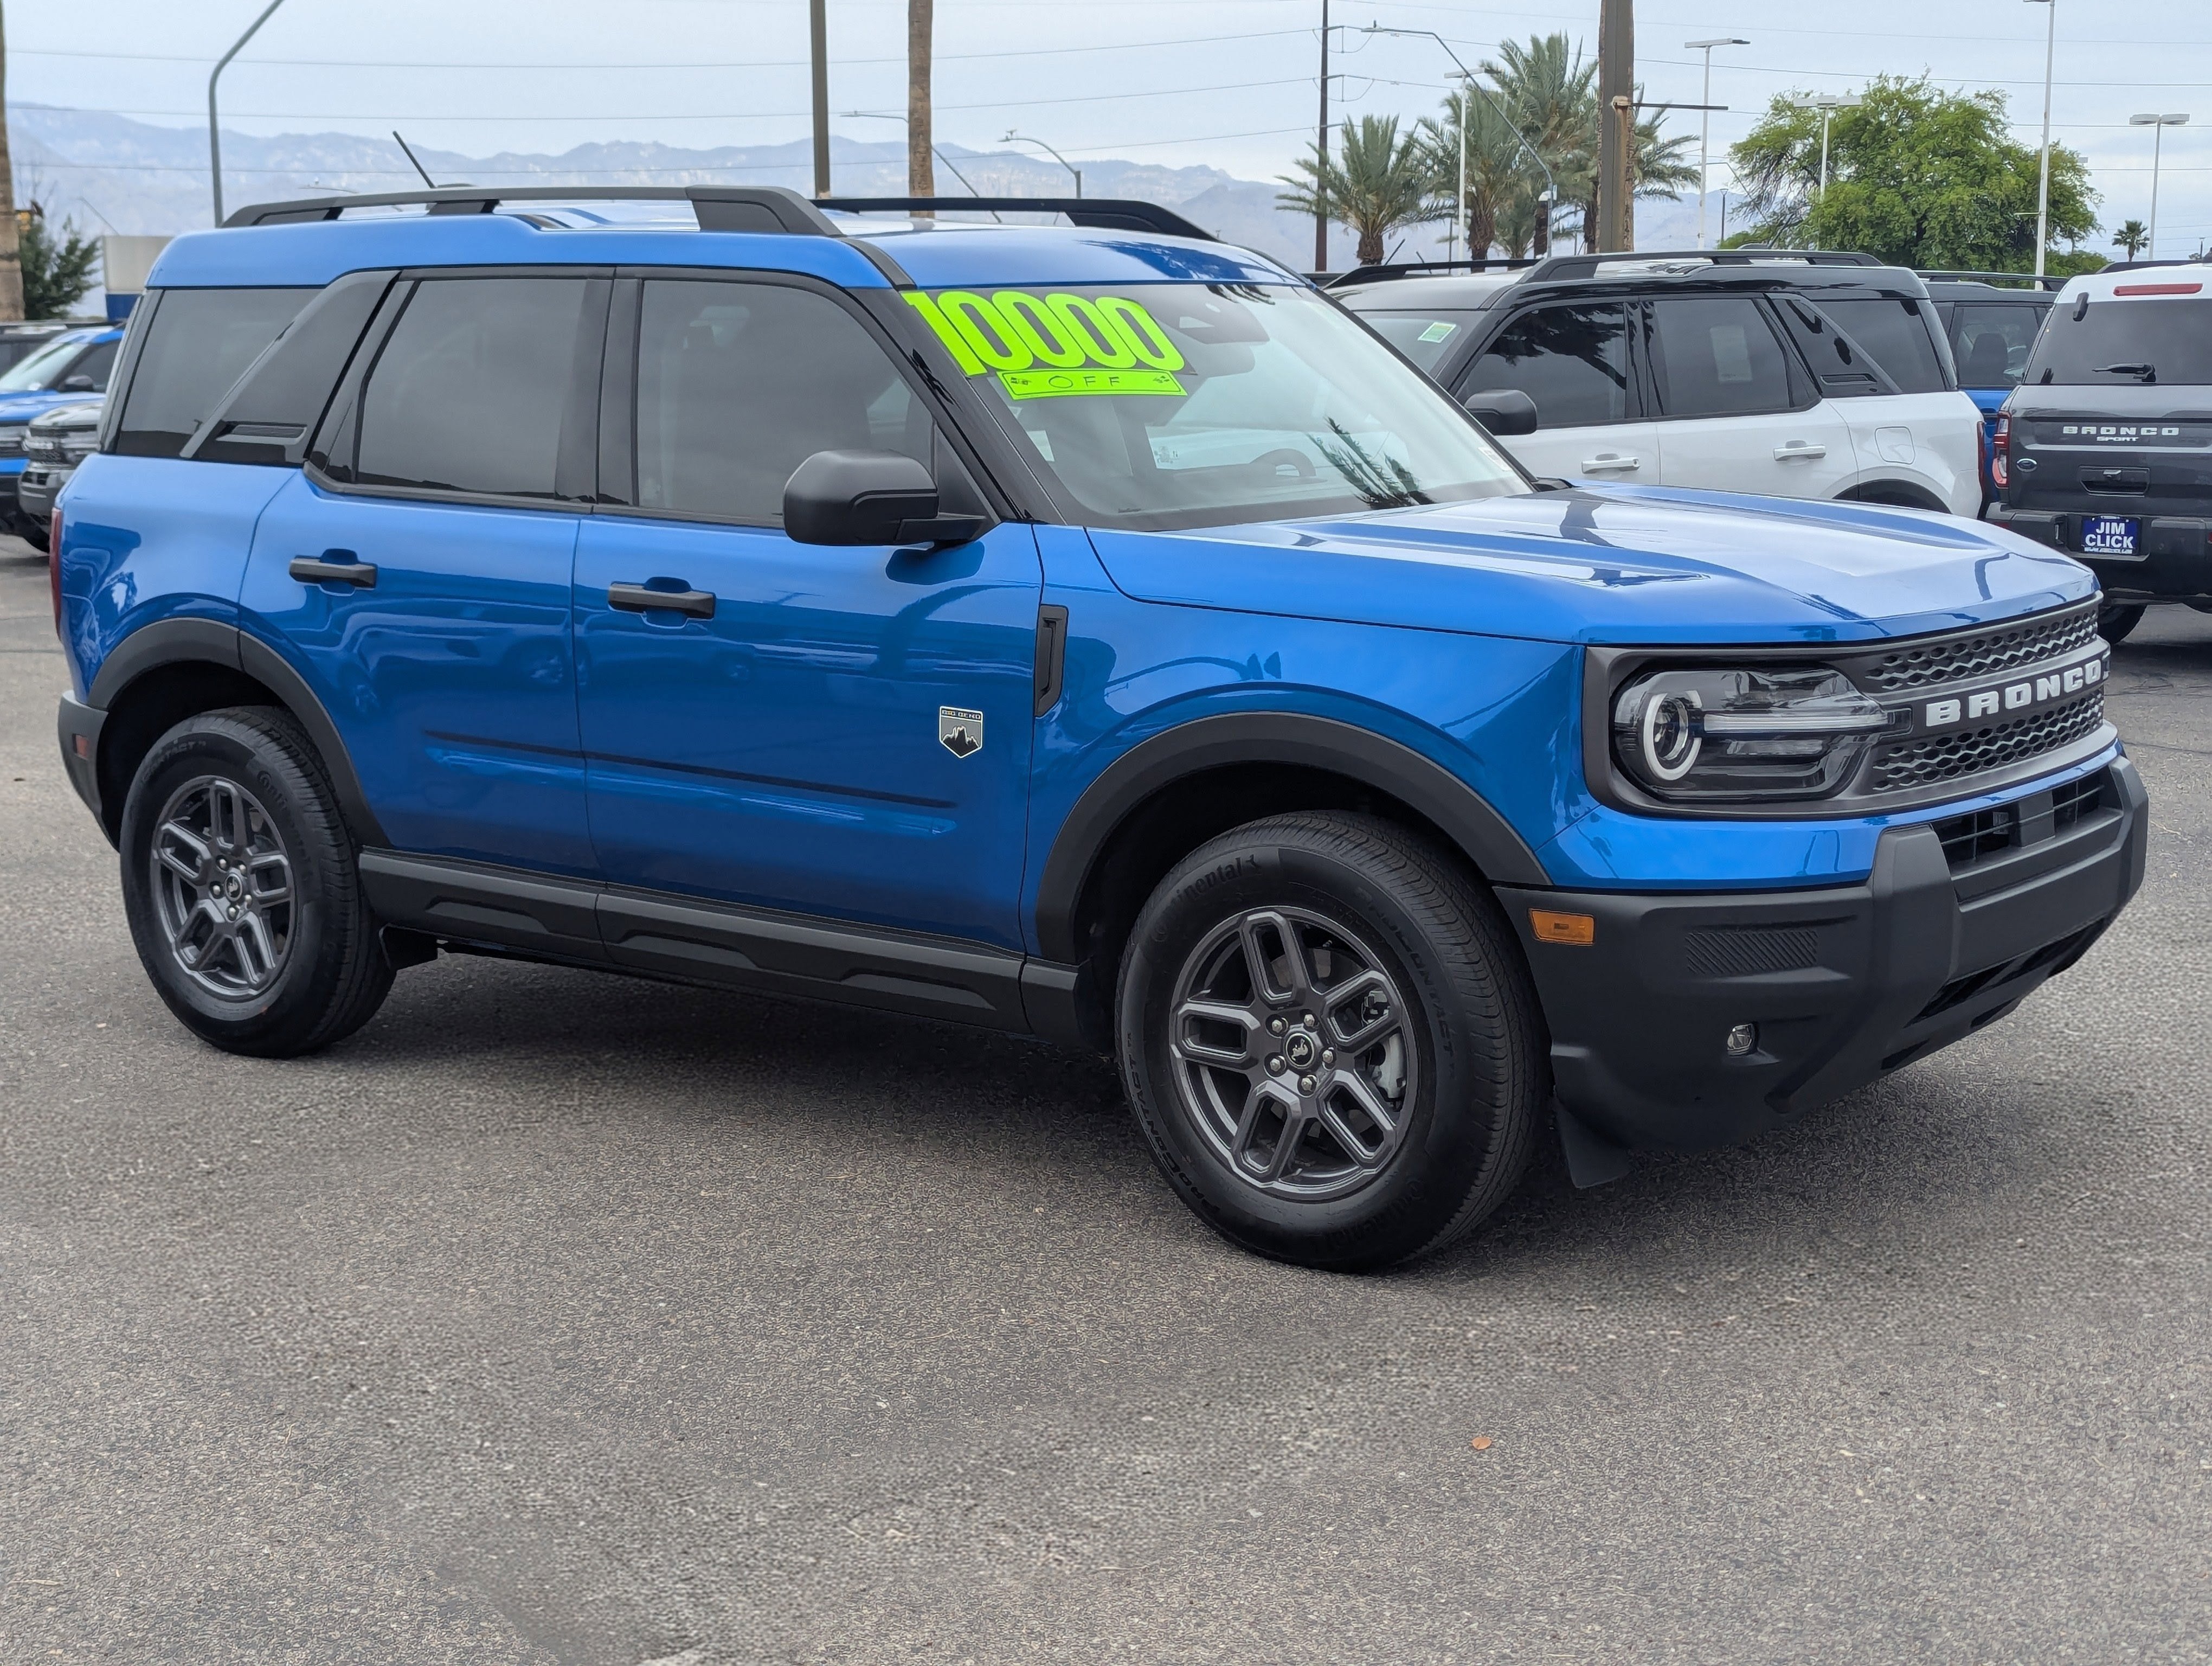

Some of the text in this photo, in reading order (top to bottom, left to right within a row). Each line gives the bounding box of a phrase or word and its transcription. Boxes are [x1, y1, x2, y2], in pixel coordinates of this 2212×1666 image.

[901, 291, 1185, 375] 10000
[1049, 375, 1120, 389] OFF
[2063, 426, 2179, 435] BRONCO
[2096, 522, 2125, 535] JIM
[2085, 534, 2133, 548] CLICK
[1926, 659, 2101, 727] BRONCO
